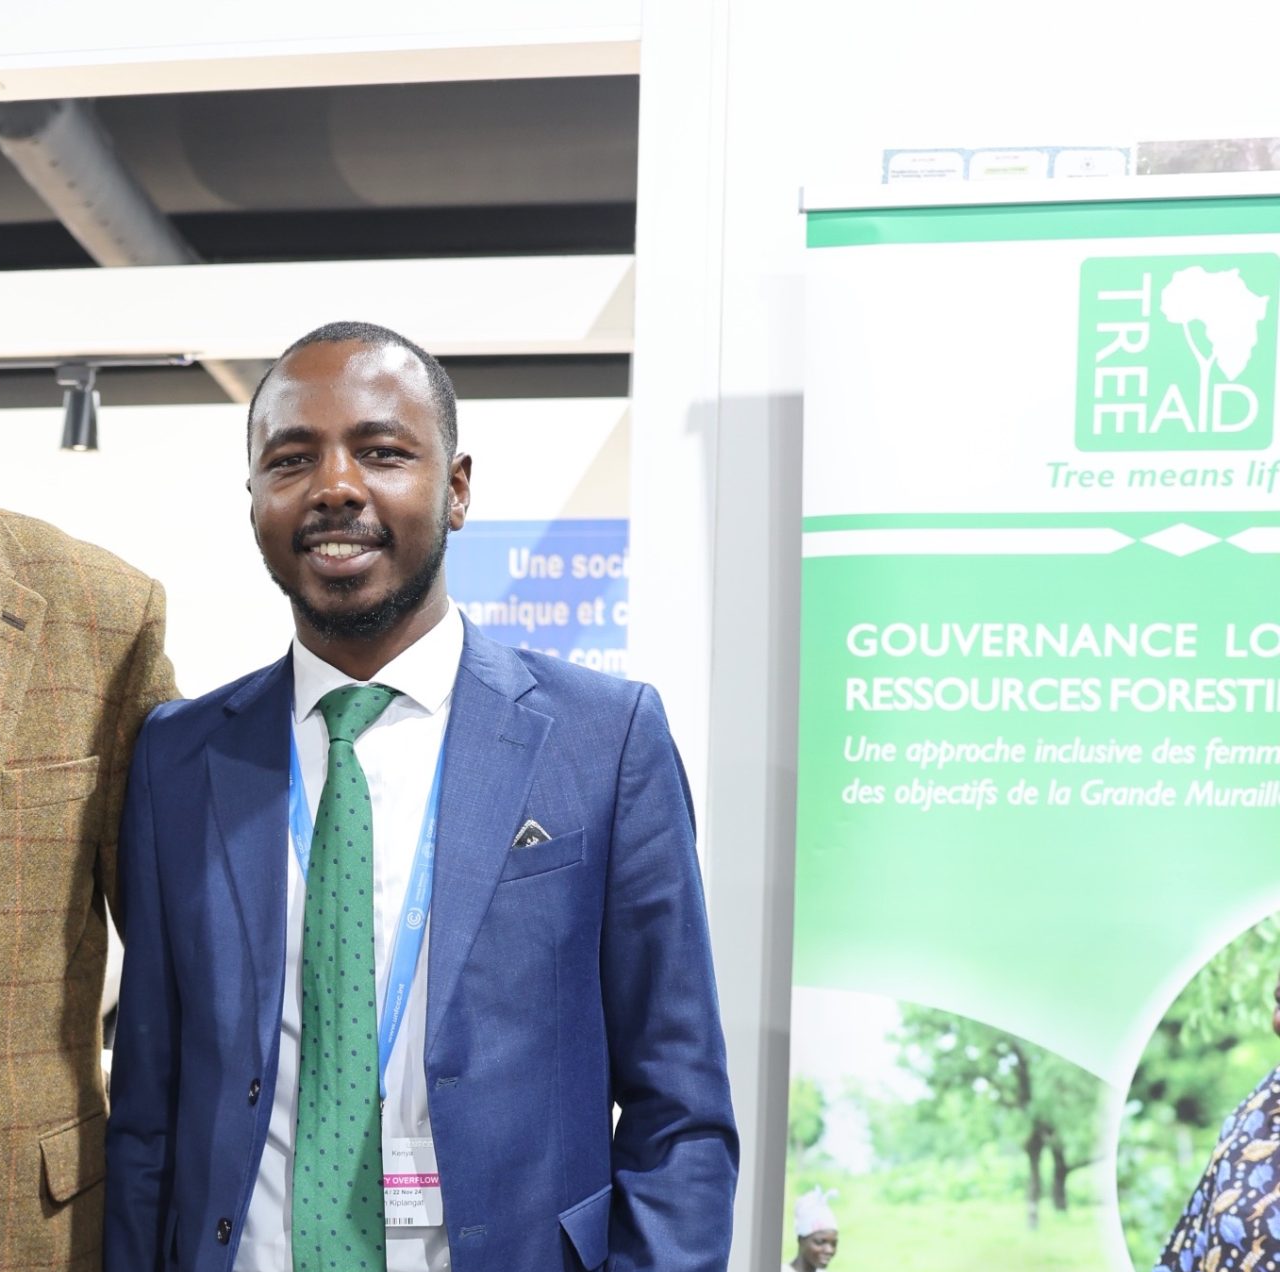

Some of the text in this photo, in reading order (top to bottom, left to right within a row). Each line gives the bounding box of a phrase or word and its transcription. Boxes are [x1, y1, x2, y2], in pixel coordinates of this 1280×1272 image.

[1093, 272, 1151, 435] TREE
[1149, 383, 1259, 433] AID
[1047, 460, 1280, 494] Tree means lif
[509, 547, 564, 579] Une
[577, 597, 606, 625] et
[845, 622, 1280, 658] GOUVERNANCE LO
[845, 676, 1102, 712] RESSOURCES
[842, 735, 897, 763] Une
[905, 736, 1026, 769] approche
[1034, 736, 1142, 764] inclusive
[1151, 736, 1196, 764] des
[841, 778, 1280, 811] des objectifs de la Grande Muraill
[392, 1176, 439, 1185] OVERFLOW
